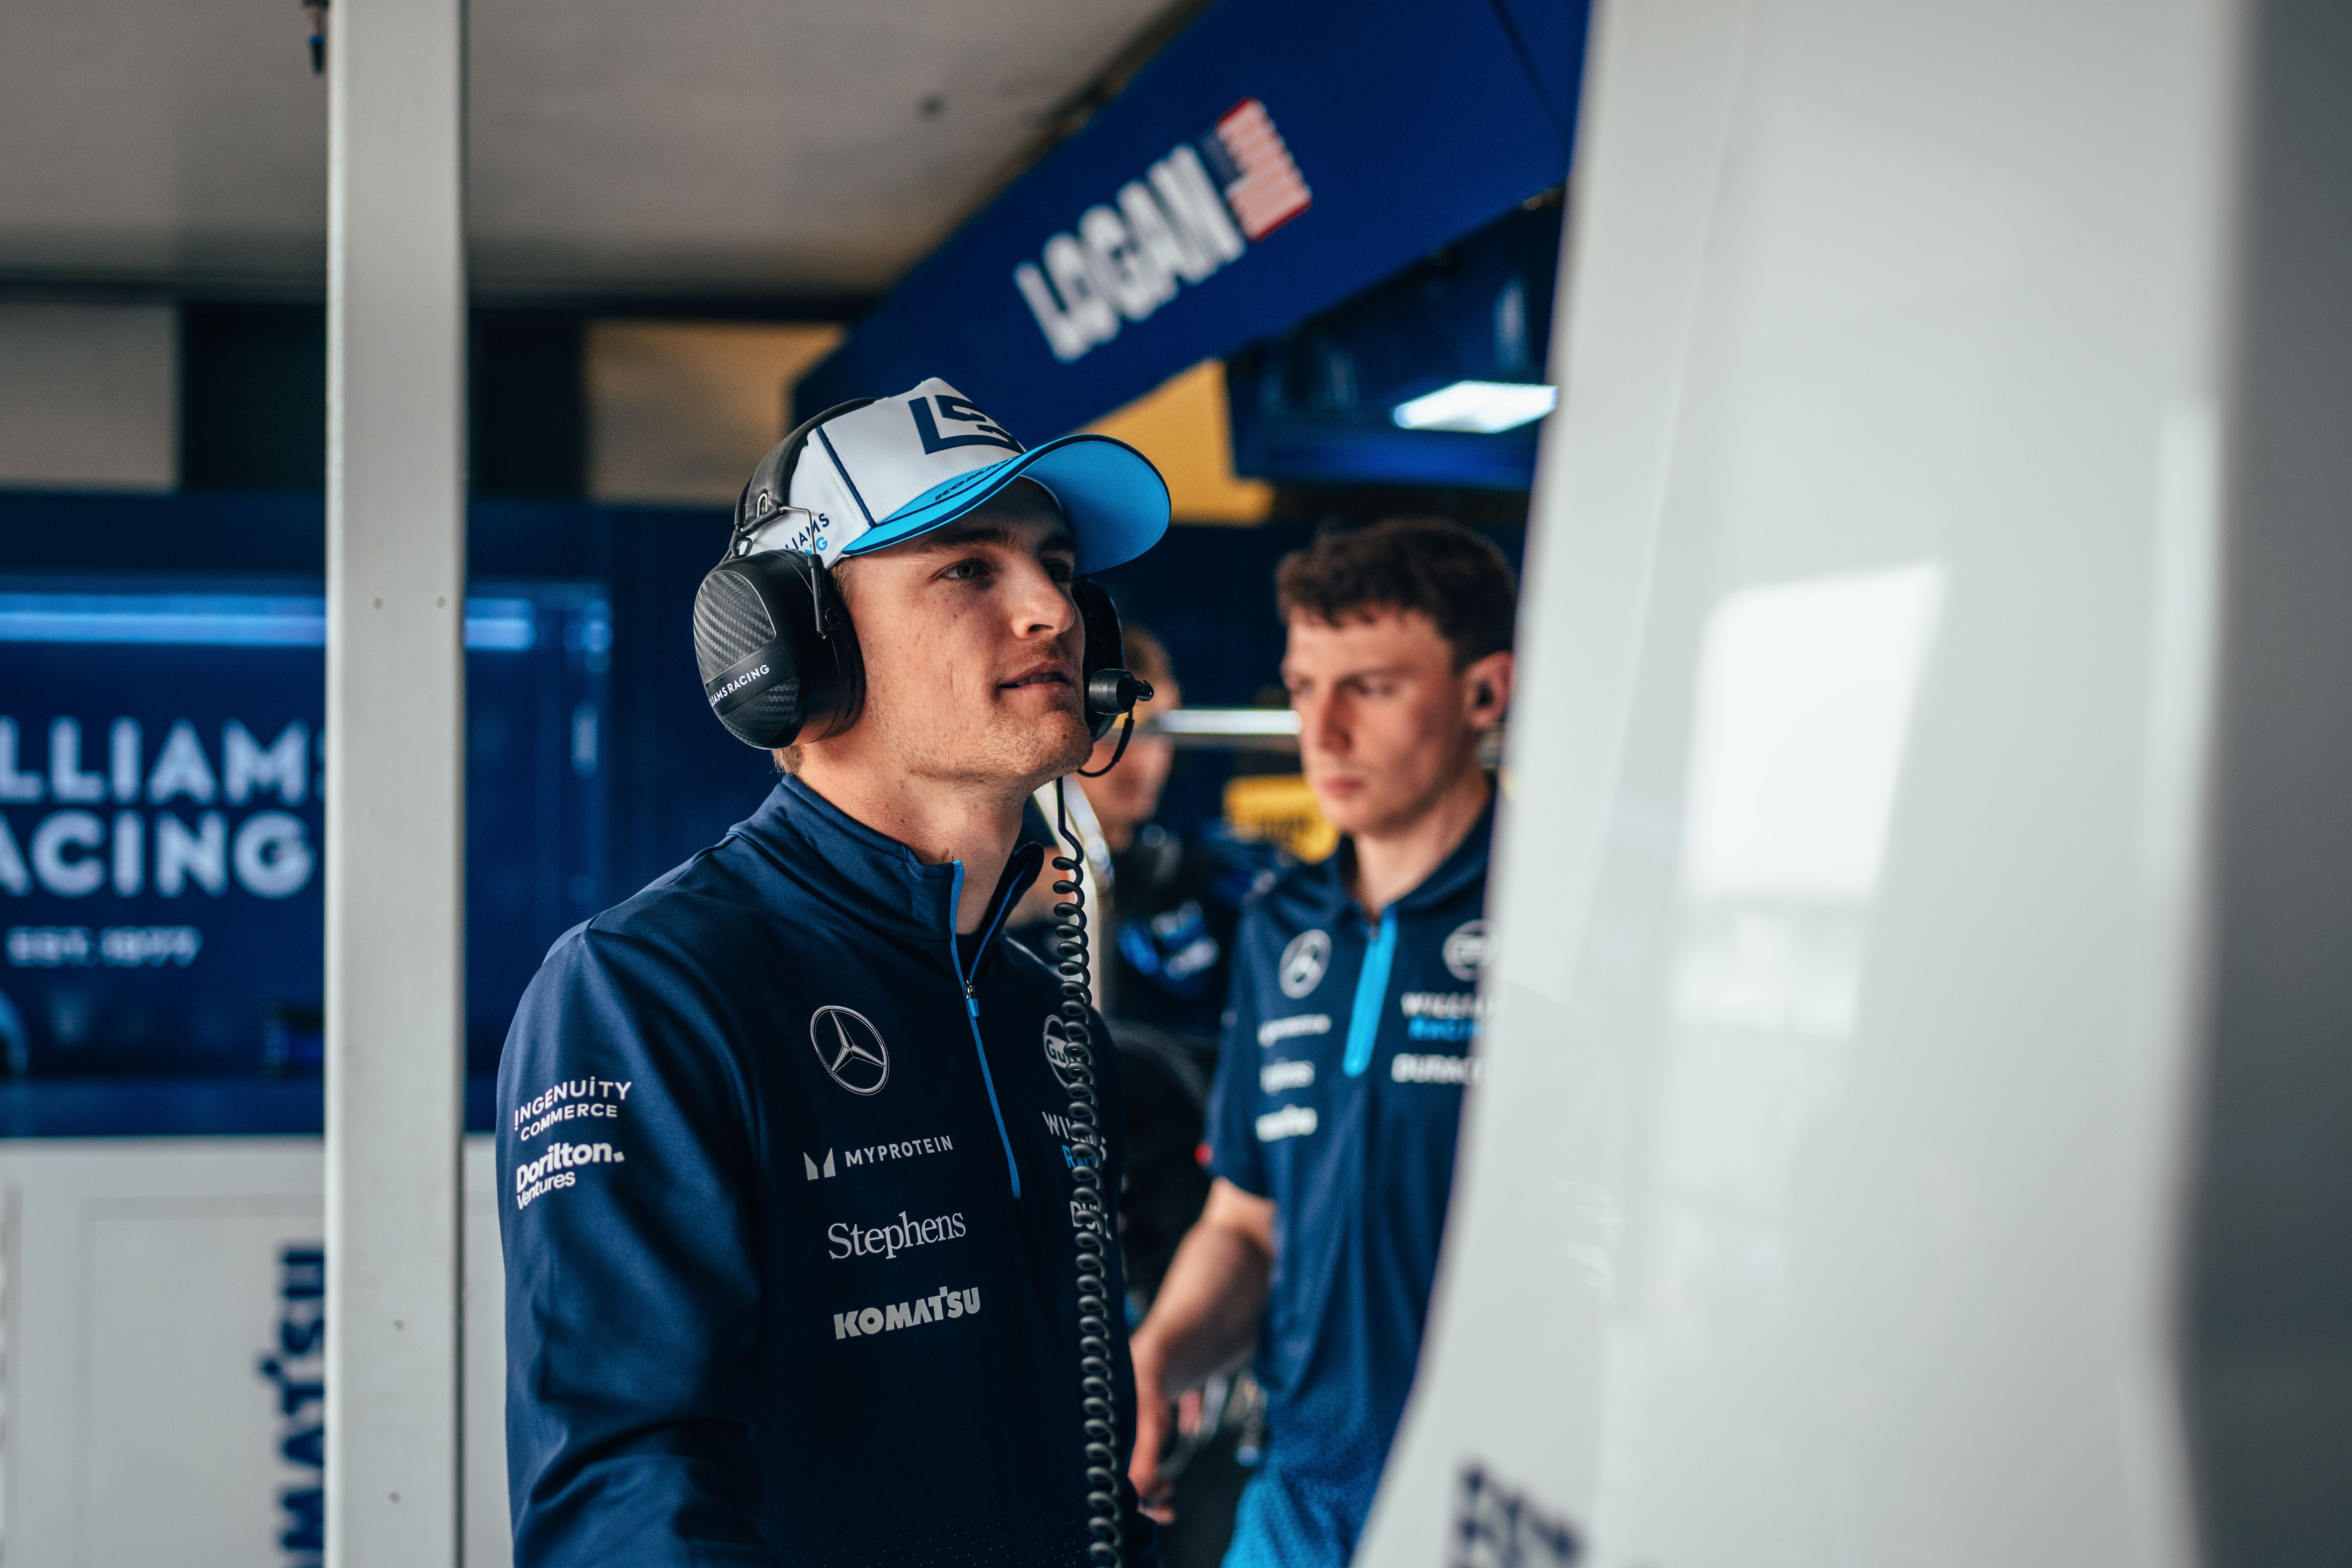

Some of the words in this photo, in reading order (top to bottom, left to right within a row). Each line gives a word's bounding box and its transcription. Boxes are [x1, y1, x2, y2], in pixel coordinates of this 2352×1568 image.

[1013, 144, 1246, 364] LOGAN
[726, 665, 770, 693] RACING
[0, 716, 325, 806] LLIAM
[520, 1103, 618, 1141] COMMERCE
[845, 1135, 953, 1167] MYPROTEIN
[517, 1171, 576, 1210] Ventures
[827, 1211, 966, 1260] Stephens
[833, 1286, 981, 1340] KOMATSU
